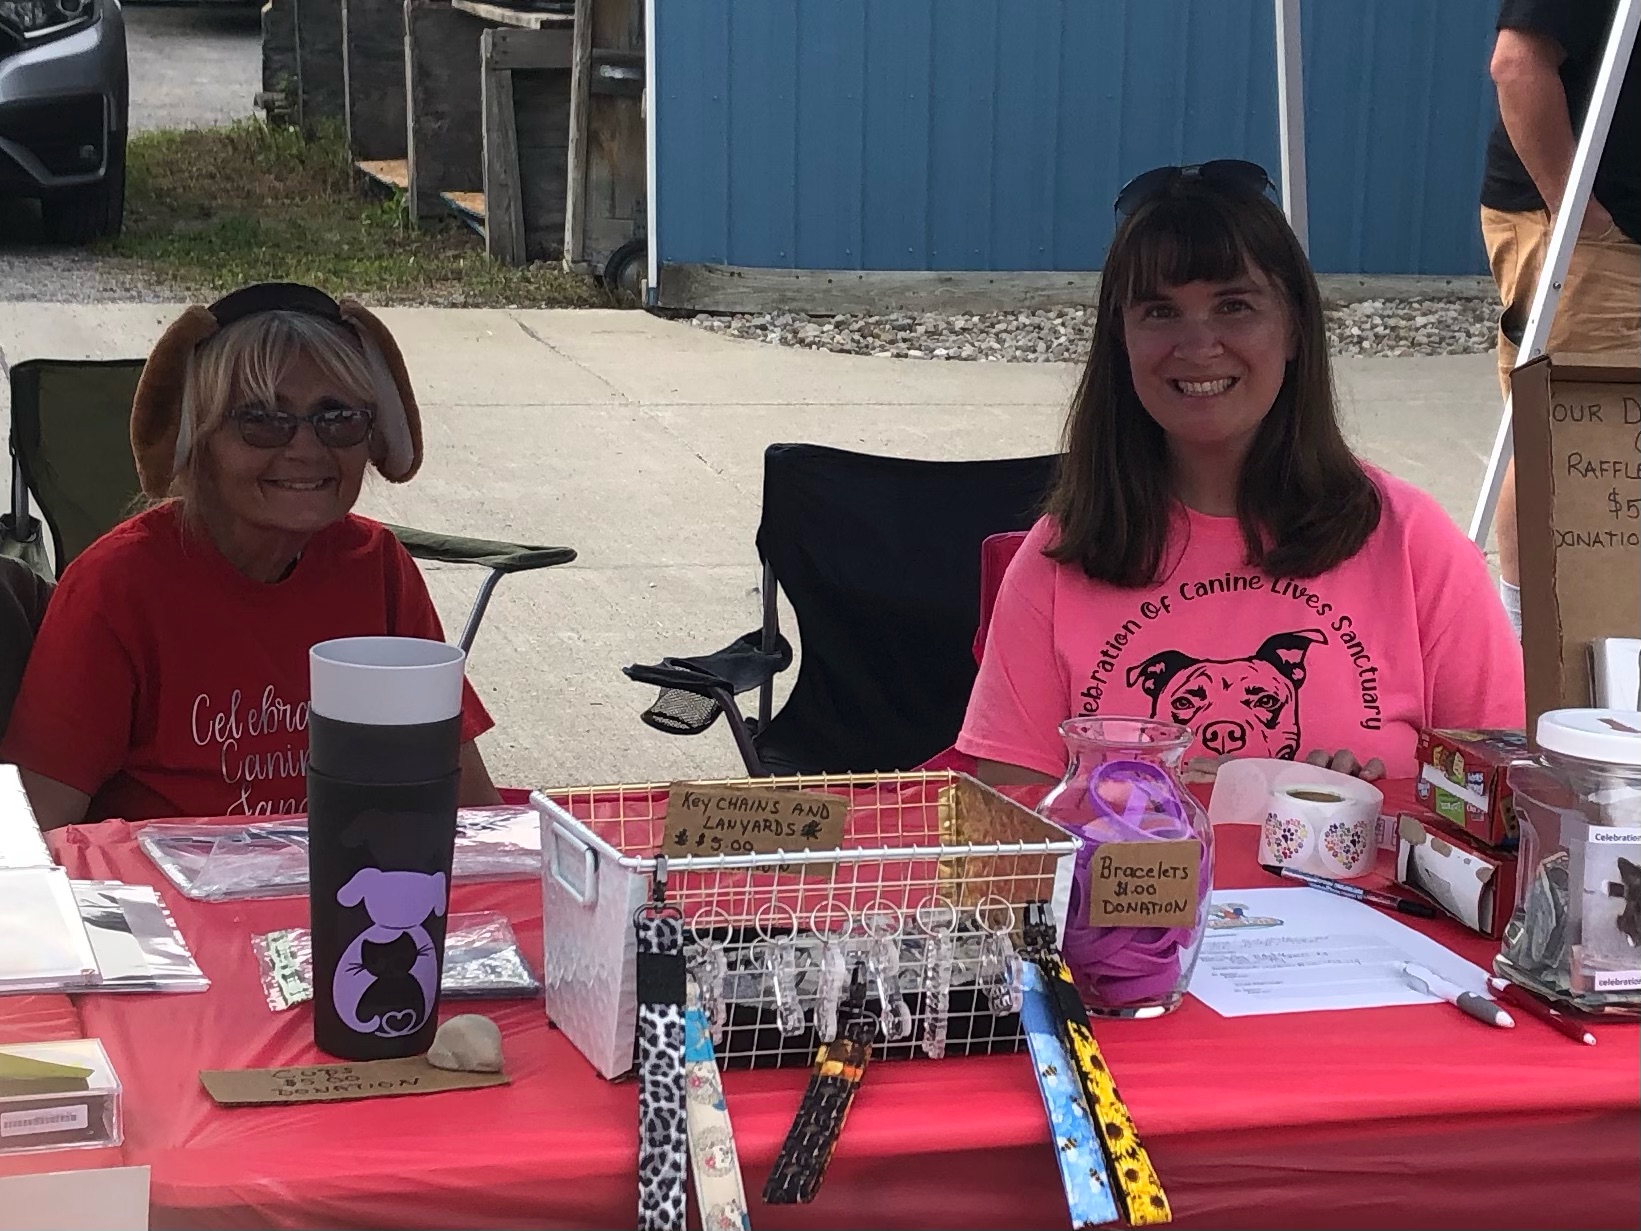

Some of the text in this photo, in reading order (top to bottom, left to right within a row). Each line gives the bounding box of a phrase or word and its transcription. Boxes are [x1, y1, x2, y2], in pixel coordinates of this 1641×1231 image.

[1140, 594, 1171, 620] Of
[1179, 572, 1265, 601] Canine
[1271, 577, 1332, 616] Lives
[1331, 615, 1382, 731] Sanctuary
[716, 796, 780, 815] CHAINS
[791, 802, 830, 820] AND
[702, 815, 797, 837] LANYARDS
[1114, 880, 1157, 897] $1.00
[1102, 899, 1188, 916] DONATION
